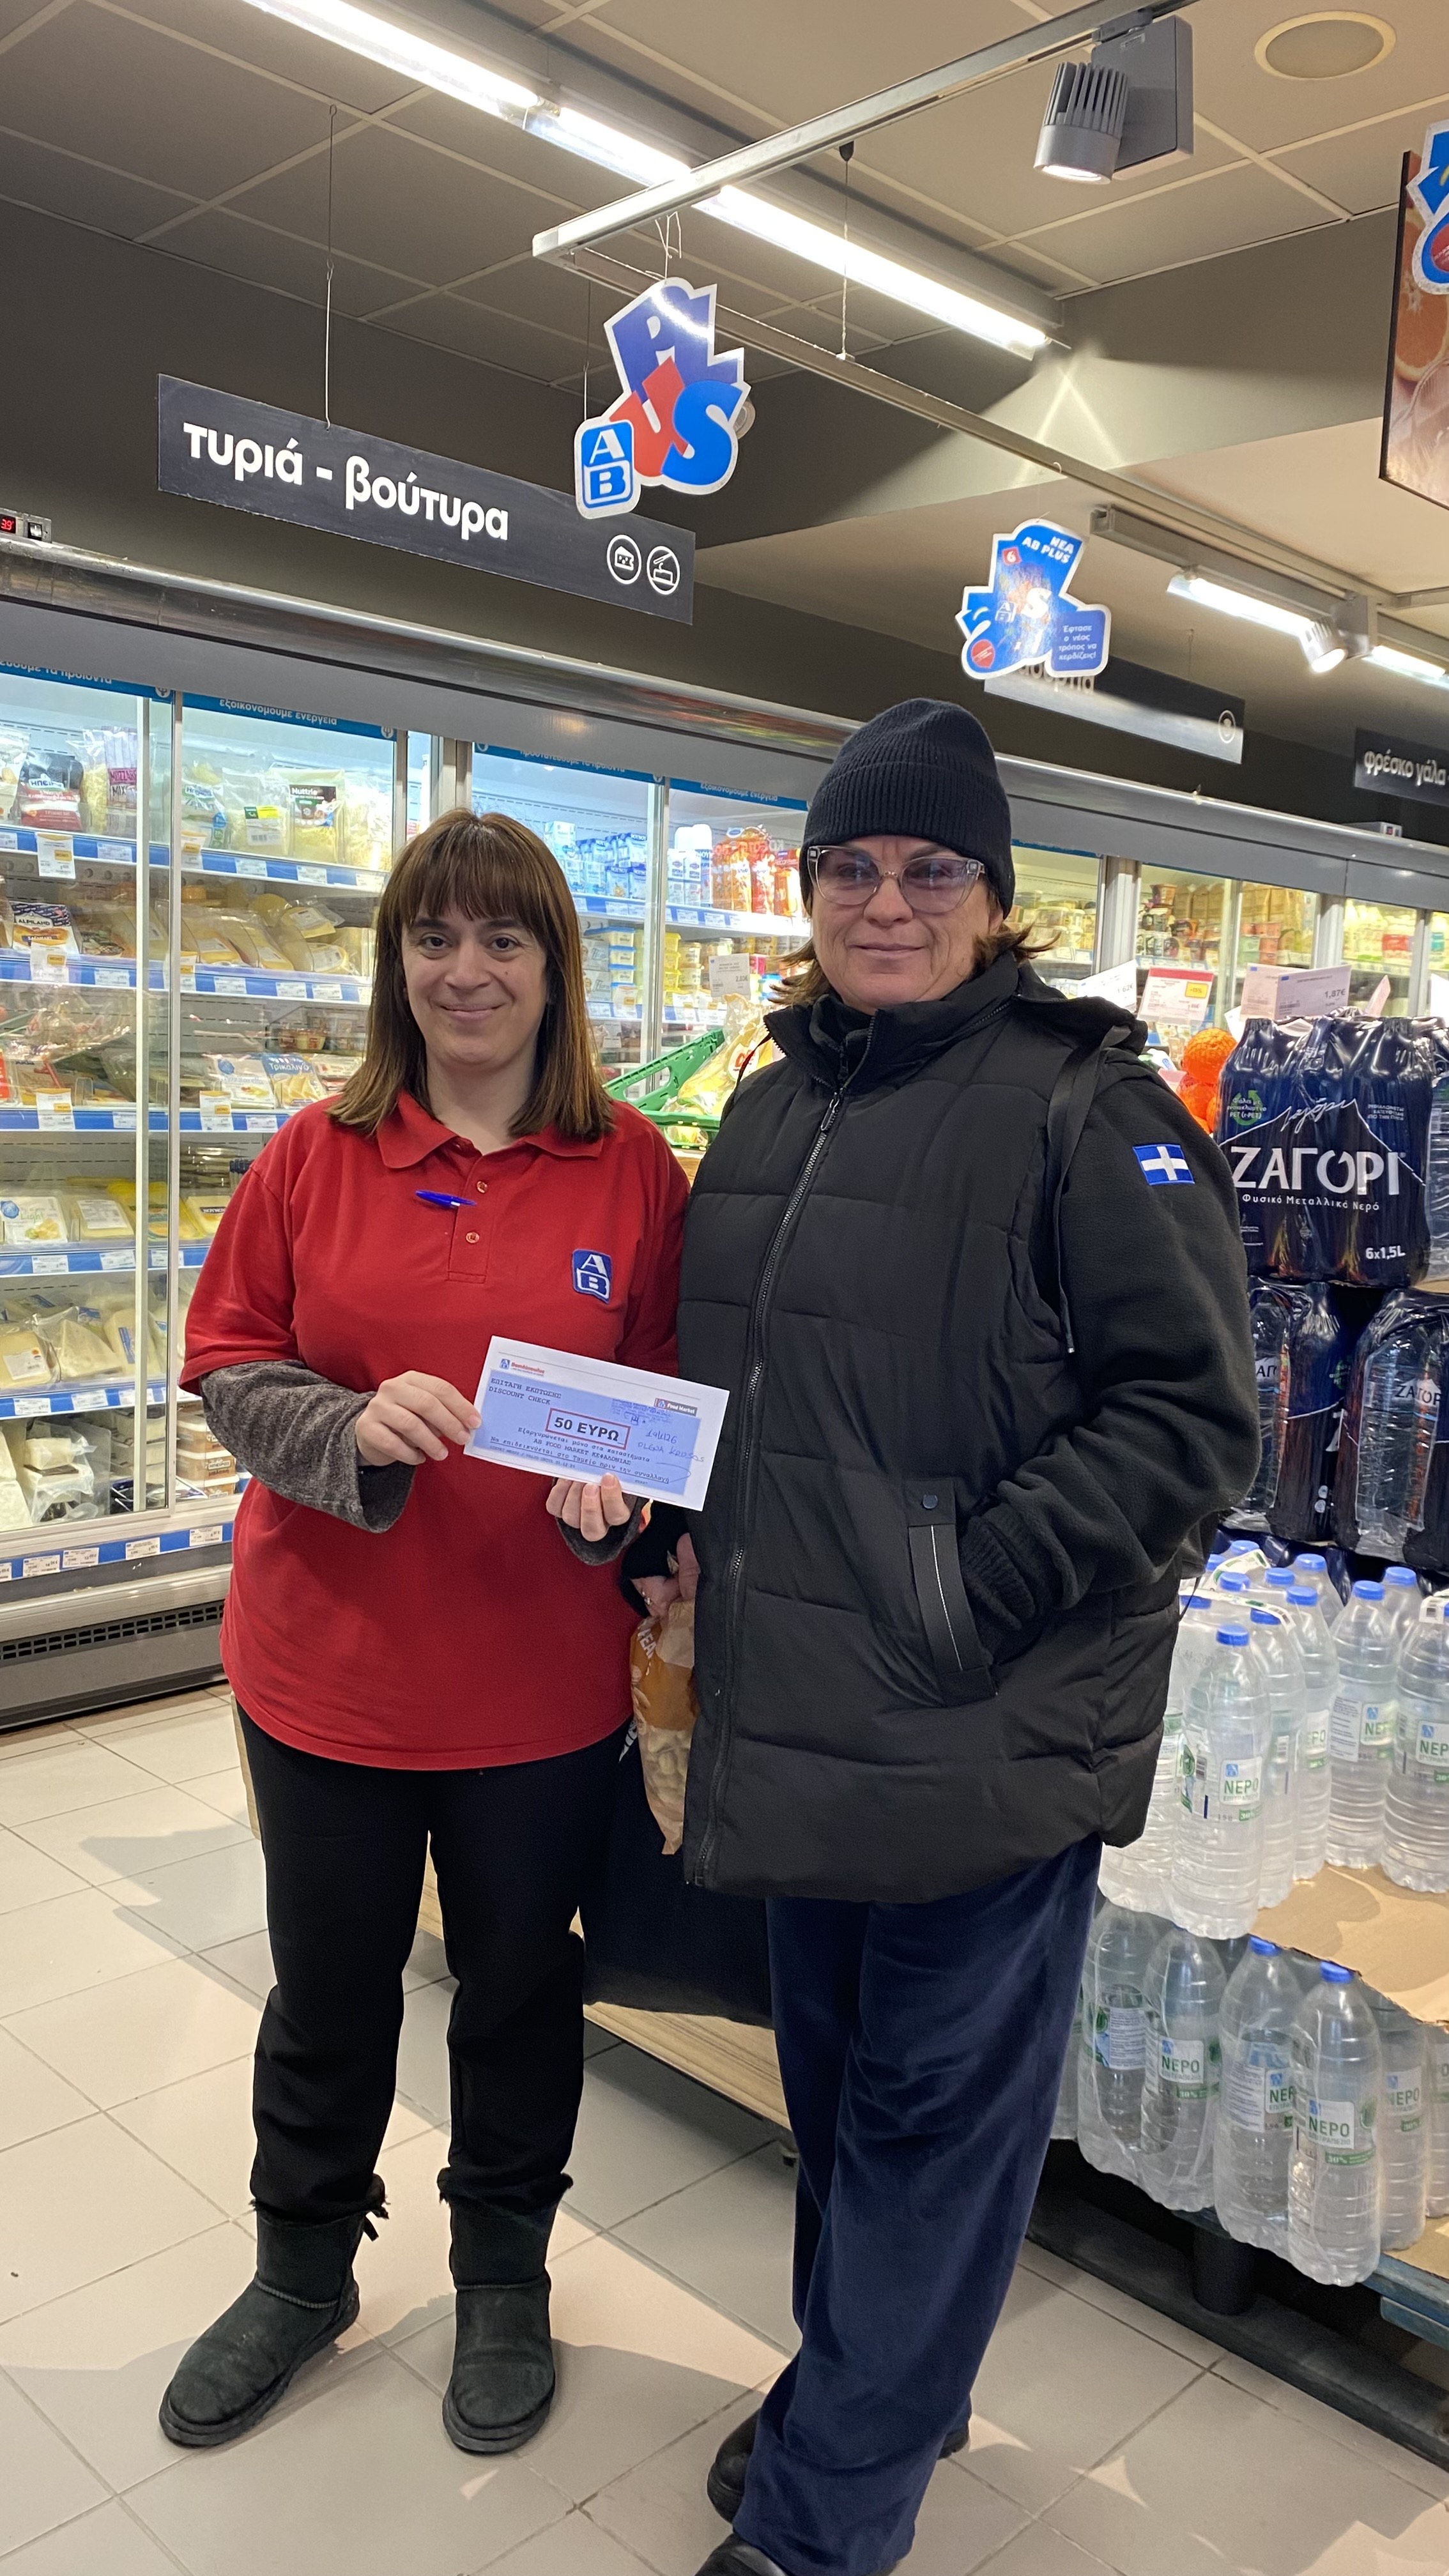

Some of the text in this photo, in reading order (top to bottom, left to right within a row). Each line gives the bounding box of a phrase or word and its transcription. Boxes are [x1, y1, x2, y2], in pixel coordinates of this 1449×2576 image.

[183, 422, 303, 487] τυριά
[345, 454, 509, 542] βούτυρα
[1041, 545, 1071, 564] PLUS
[1363, 748, 1446, 786] φρέσκο γάλα
[1324, 988, 1346, 999] 1,87€
[1230, 1146, 1400, 1195] ΖΑΓΟΡΙ
[1242, 1193, 1380, 1212] Φυσικό Μεταλλικό Νερό
[1365, 1245, 1406, 1261] 6x1,5L
[489, 1386, 551, 1406] DISCOUNT CHECK
[491, 1377, 562, 1399] ΕΠΙΤΑΓΗ ΕΚΠΤΩΣΗΣ
[1395, 1384, 1441, 1406] ΖΑΓΟΡ
[554, 1417, 572, 1430] 50
[546, 1441, 562, 1449] FOOD
[564, 1445, 589, 1455] MARKET
[572, 1439, 588, 1448] μόνο
[607, 1449, 650, 1462] καταστήματα
[557, 1451, 569, 1459] στο
[599, 1461, 616, 1470] πριν
[1420, 1740, 1449, 1756] ΝΕΡ
[1224, 1777, 1259, 1795] ΝΕΡΟ
[1161, 2055, 1200, 2073] ΝΕΡΟ
[1269, 2086, 1296, 2103] ΝΕΡ
[1308, 2116, 1350, 2138] ΝΕΡΟ
